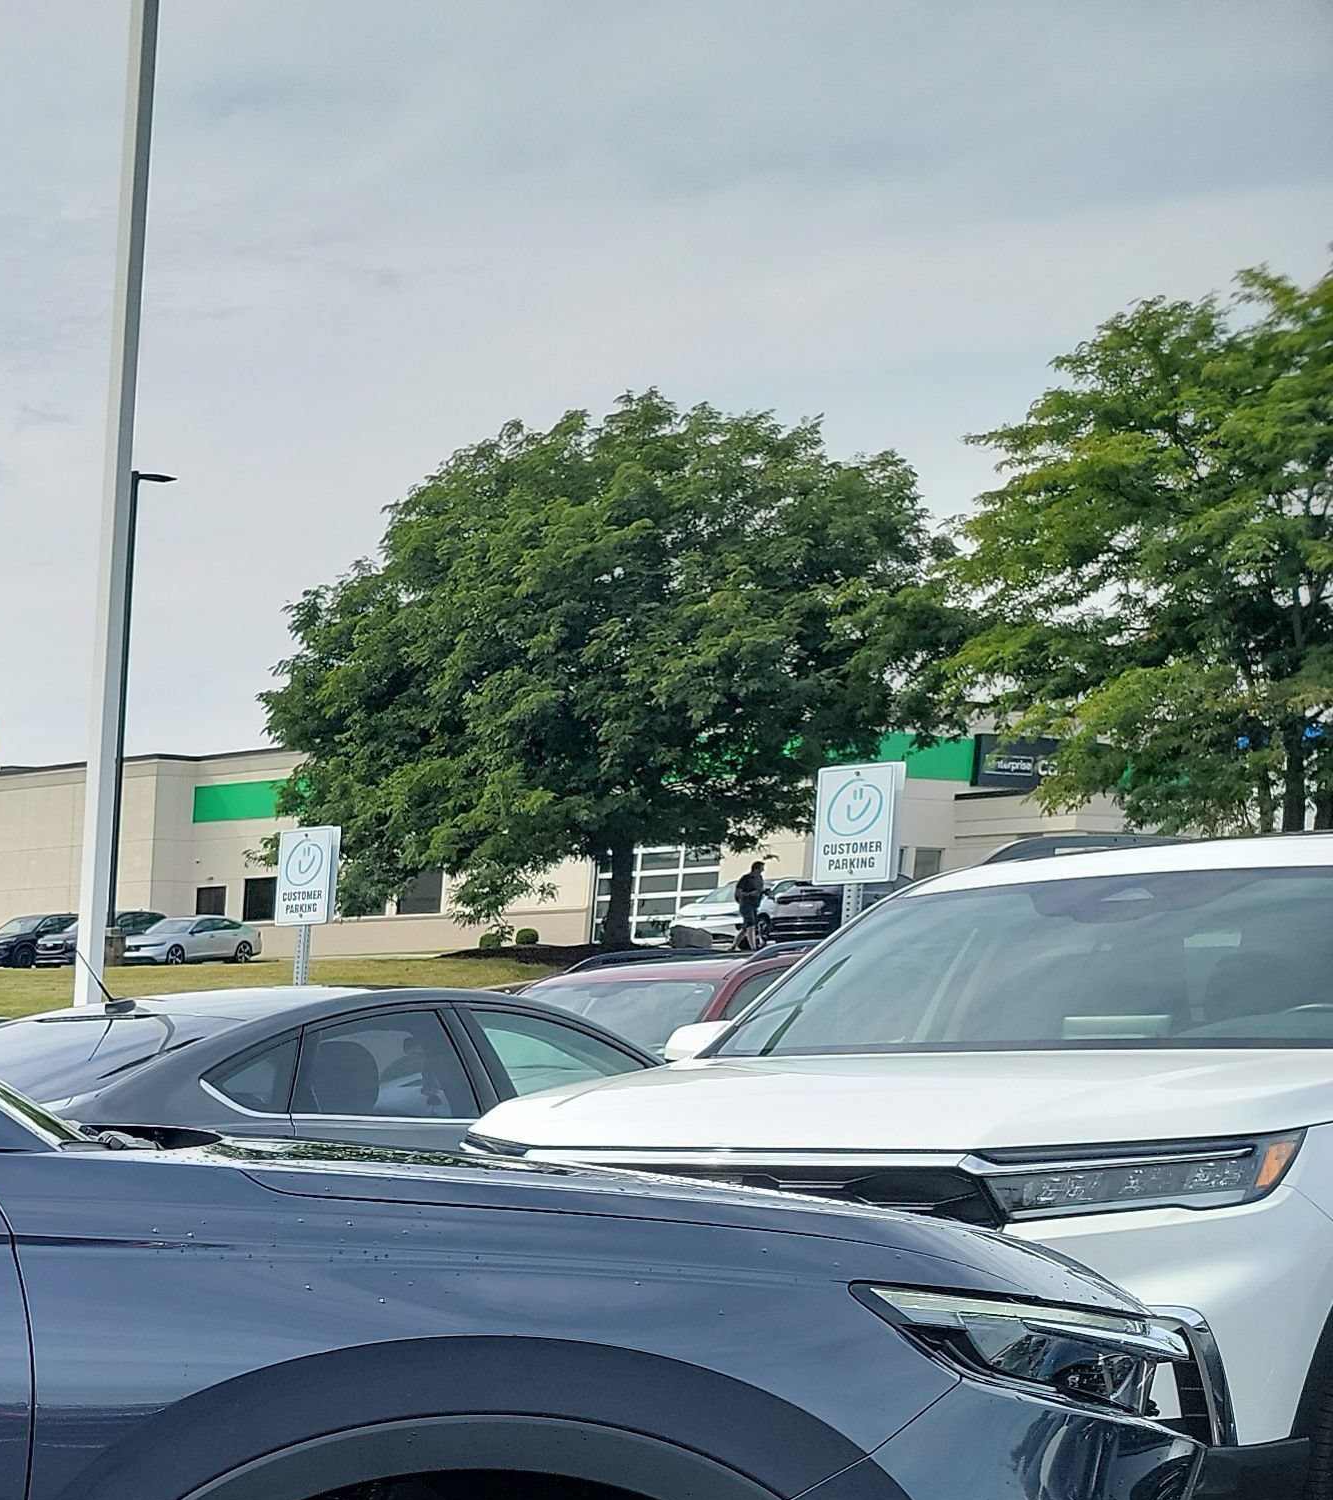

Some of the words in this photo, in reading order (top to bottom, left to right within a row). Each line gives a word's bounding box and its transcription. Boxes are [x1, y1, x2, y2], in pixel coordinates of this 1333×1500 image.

[823, 840, 882, 856] CUSTOMER
[828, 856, 875, 871] PARKING
[282, 889, 323, 902] CUSTOMER
[285, 902, 318, 914] PARKING
